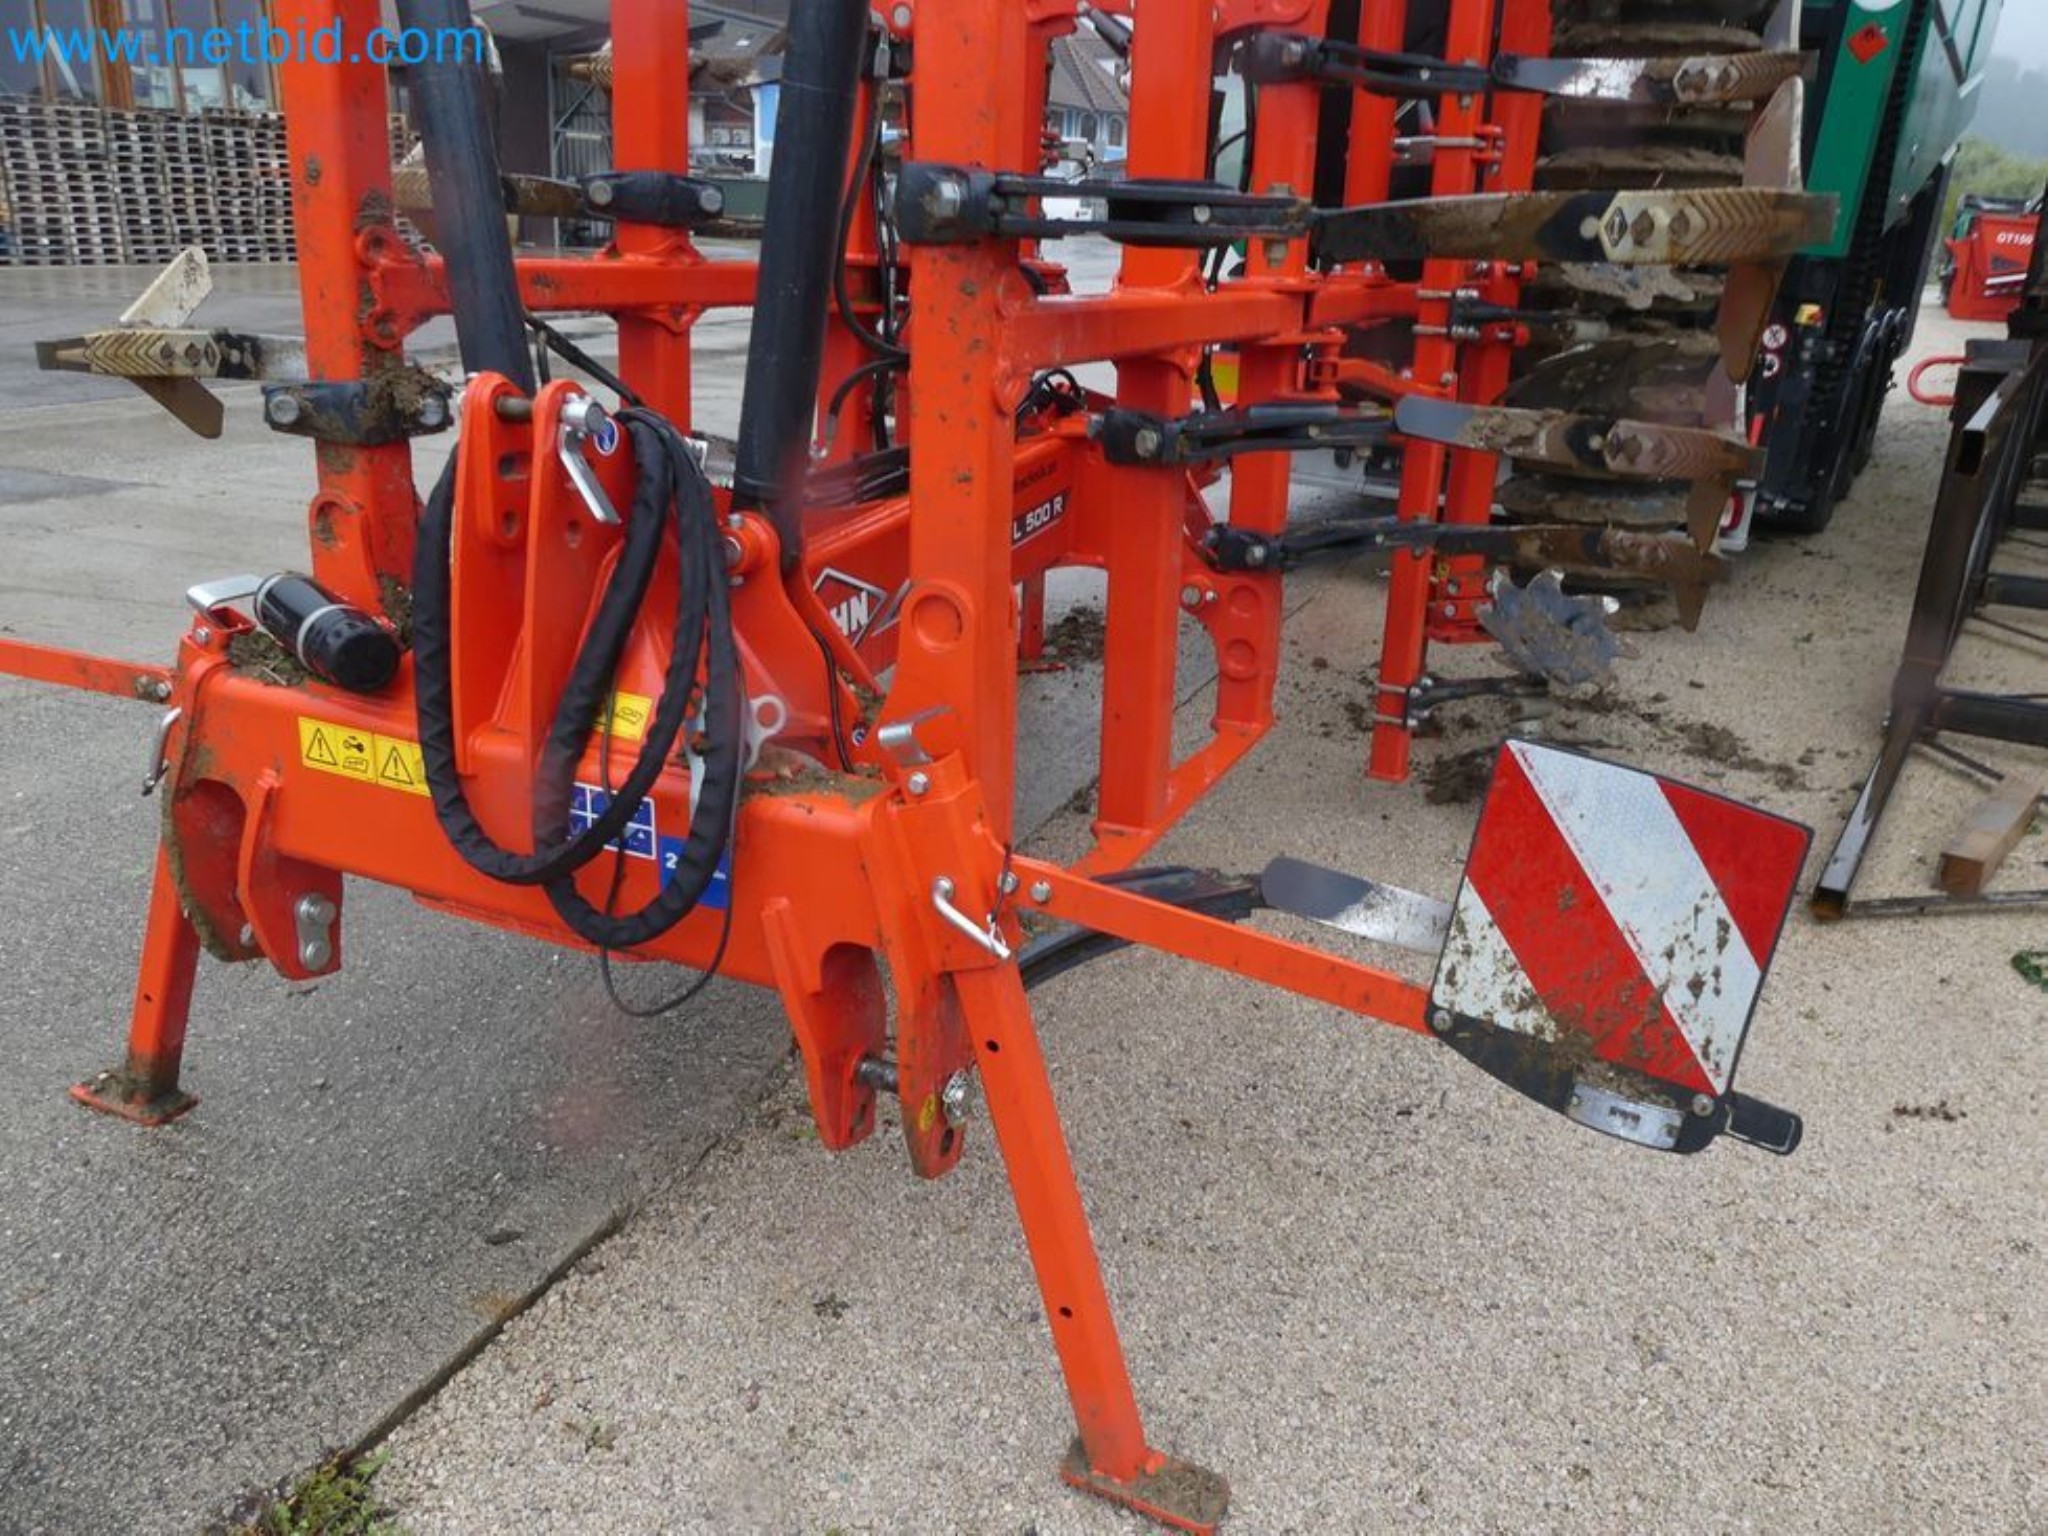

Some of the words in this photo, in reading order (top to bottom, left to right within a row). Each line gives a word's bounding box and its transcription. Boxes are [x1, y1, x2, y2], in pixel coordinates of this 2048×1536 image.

[1025, 501, 1051, 532] 500
[1052, 495, 1063, 516] R
[829, 589, 869, 636] HN
